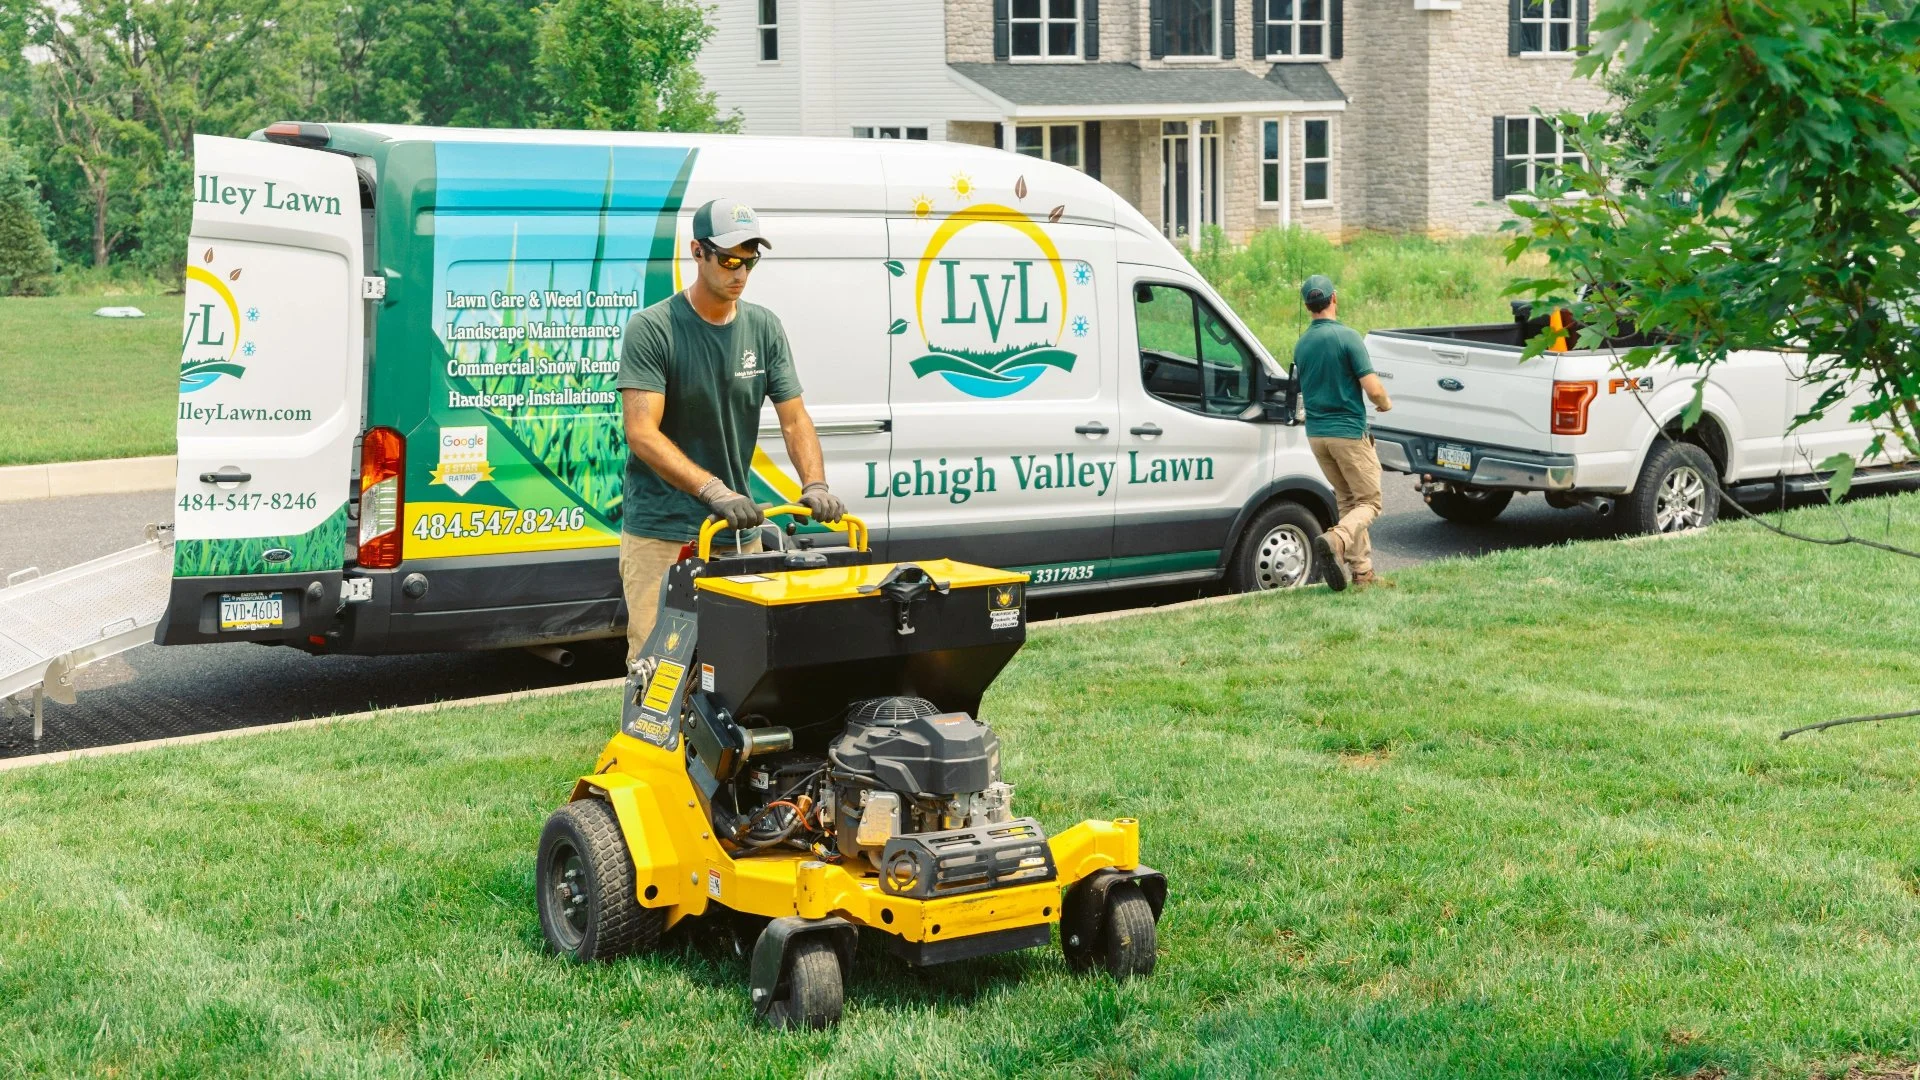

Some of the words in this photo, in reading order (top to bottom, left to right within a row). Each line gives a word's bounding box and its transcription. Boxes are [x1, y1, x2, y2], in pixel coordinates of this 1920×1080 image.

[194, 174, 257, 215] lley
[264, 181, 342, 216] Lawn
[446, 291, 487, 309] Lawn
[490, 291, 524, 308] Care
[529, 291, 541, 308] &
[544, 290, 582, 308] Weed
[586, 290, 638, 308] Control
[939, 260, 1048, 343] LVL
[447, 322, 525, 343] Landscape
[528, 322, 621, 340] Maintenance
[447, 357, 535, 377] Commercial
[539, 357, 577, 374] Snow
[580, 357, 621, 374] Remo
[1608, 376, 1654, 394] FX4
[448, 391, 525, 410] Hardscape
[528, 388, 616, 406] Installations
[442, 434, 484, 449] Google
[445, 465, 451, 473] 5
[452, 463, 479, 473] STAR
[448, 474, 477, 482] RATING
[865, 456, 997, 505] Lehigh
[1010, 452, 1116, 497] Valley
[1127, 451, 1215, 484] Lawn
[178, 492, 317, 512] 484-547-8246
[412, 506, 586, 540] 484.547.8246
[1034, 565, 1095, 584] 3317835
